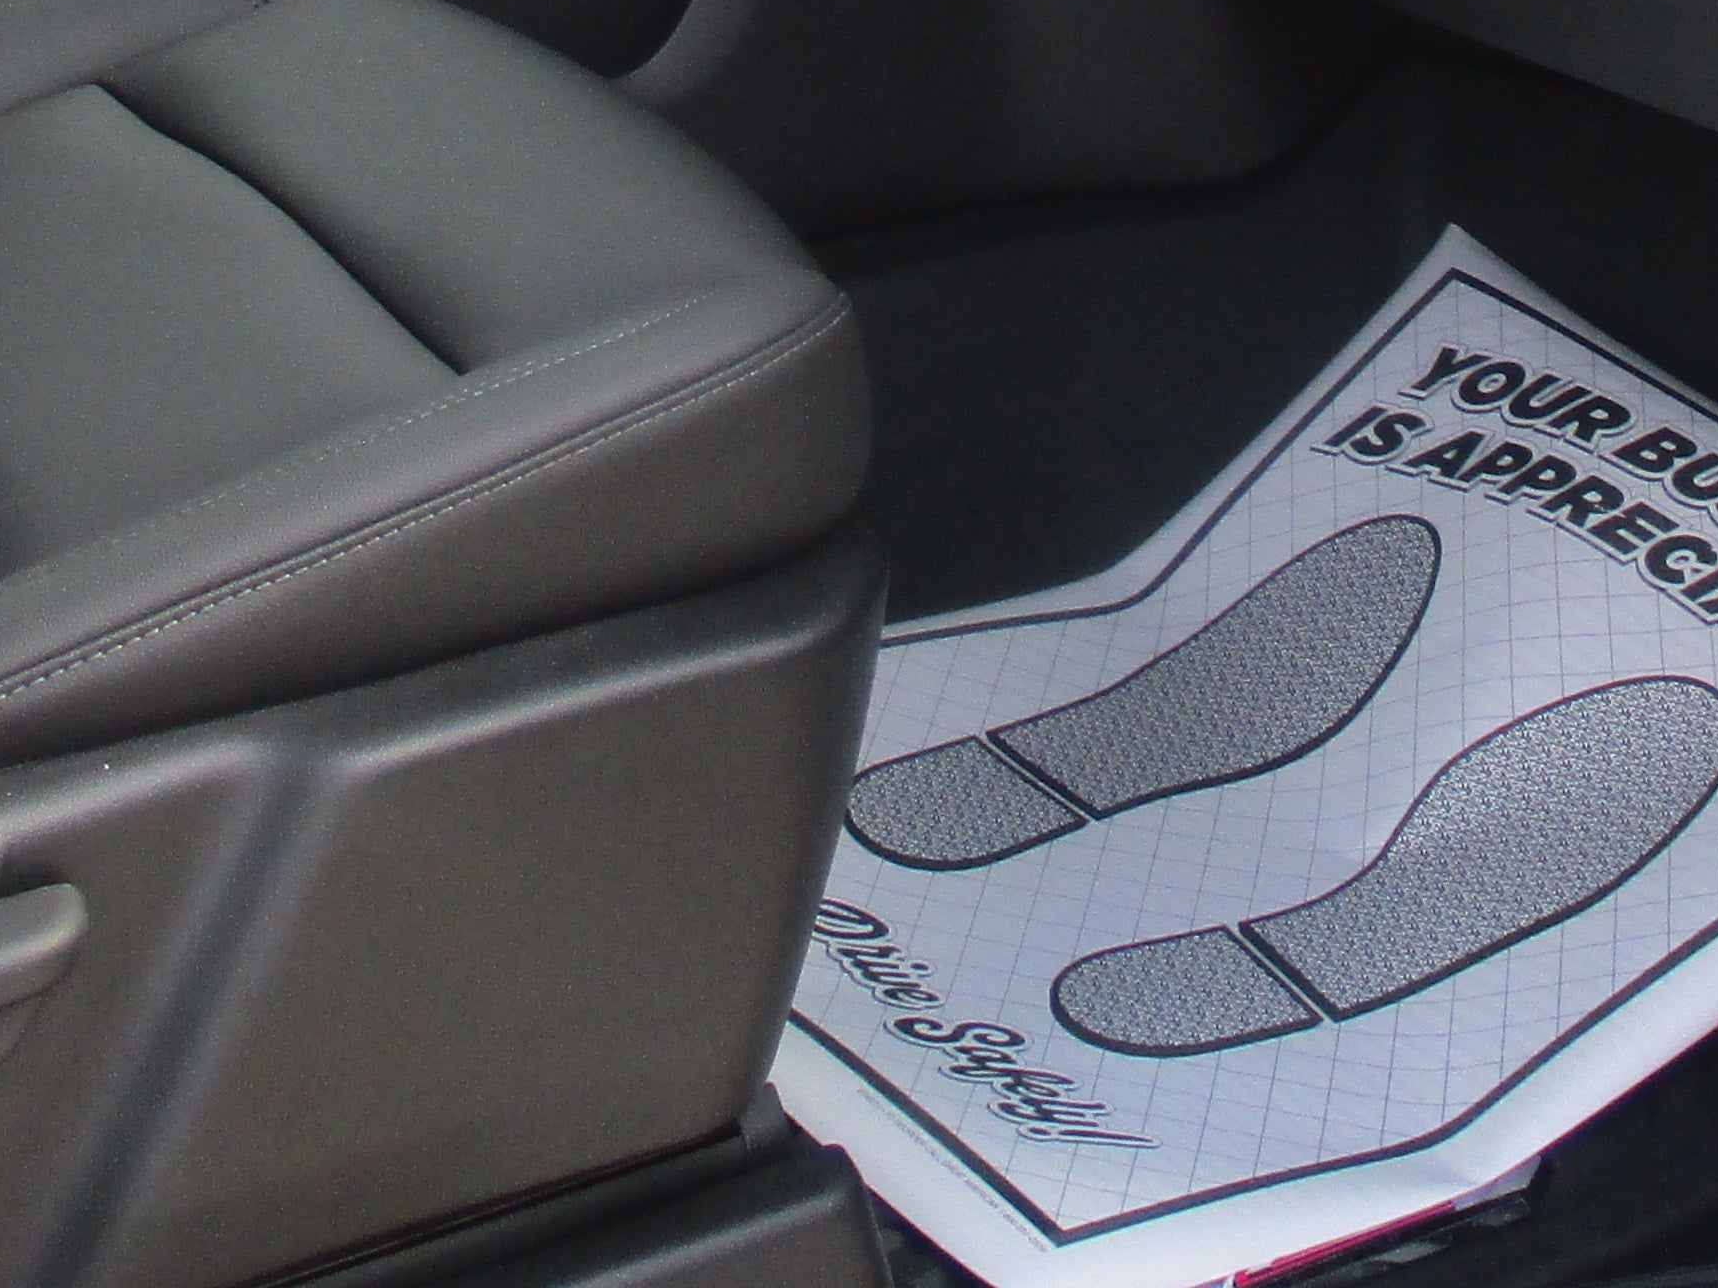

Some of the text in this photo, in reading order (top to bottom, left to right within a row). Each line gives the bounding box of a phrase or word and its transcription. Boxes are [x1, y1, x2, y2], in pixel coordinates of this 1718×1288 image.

[1323, 405, 1427, 459] IS
[1409, 346, 1635, 443] YOUR
[813, 898, 1156, 1142] Drive Safely!
